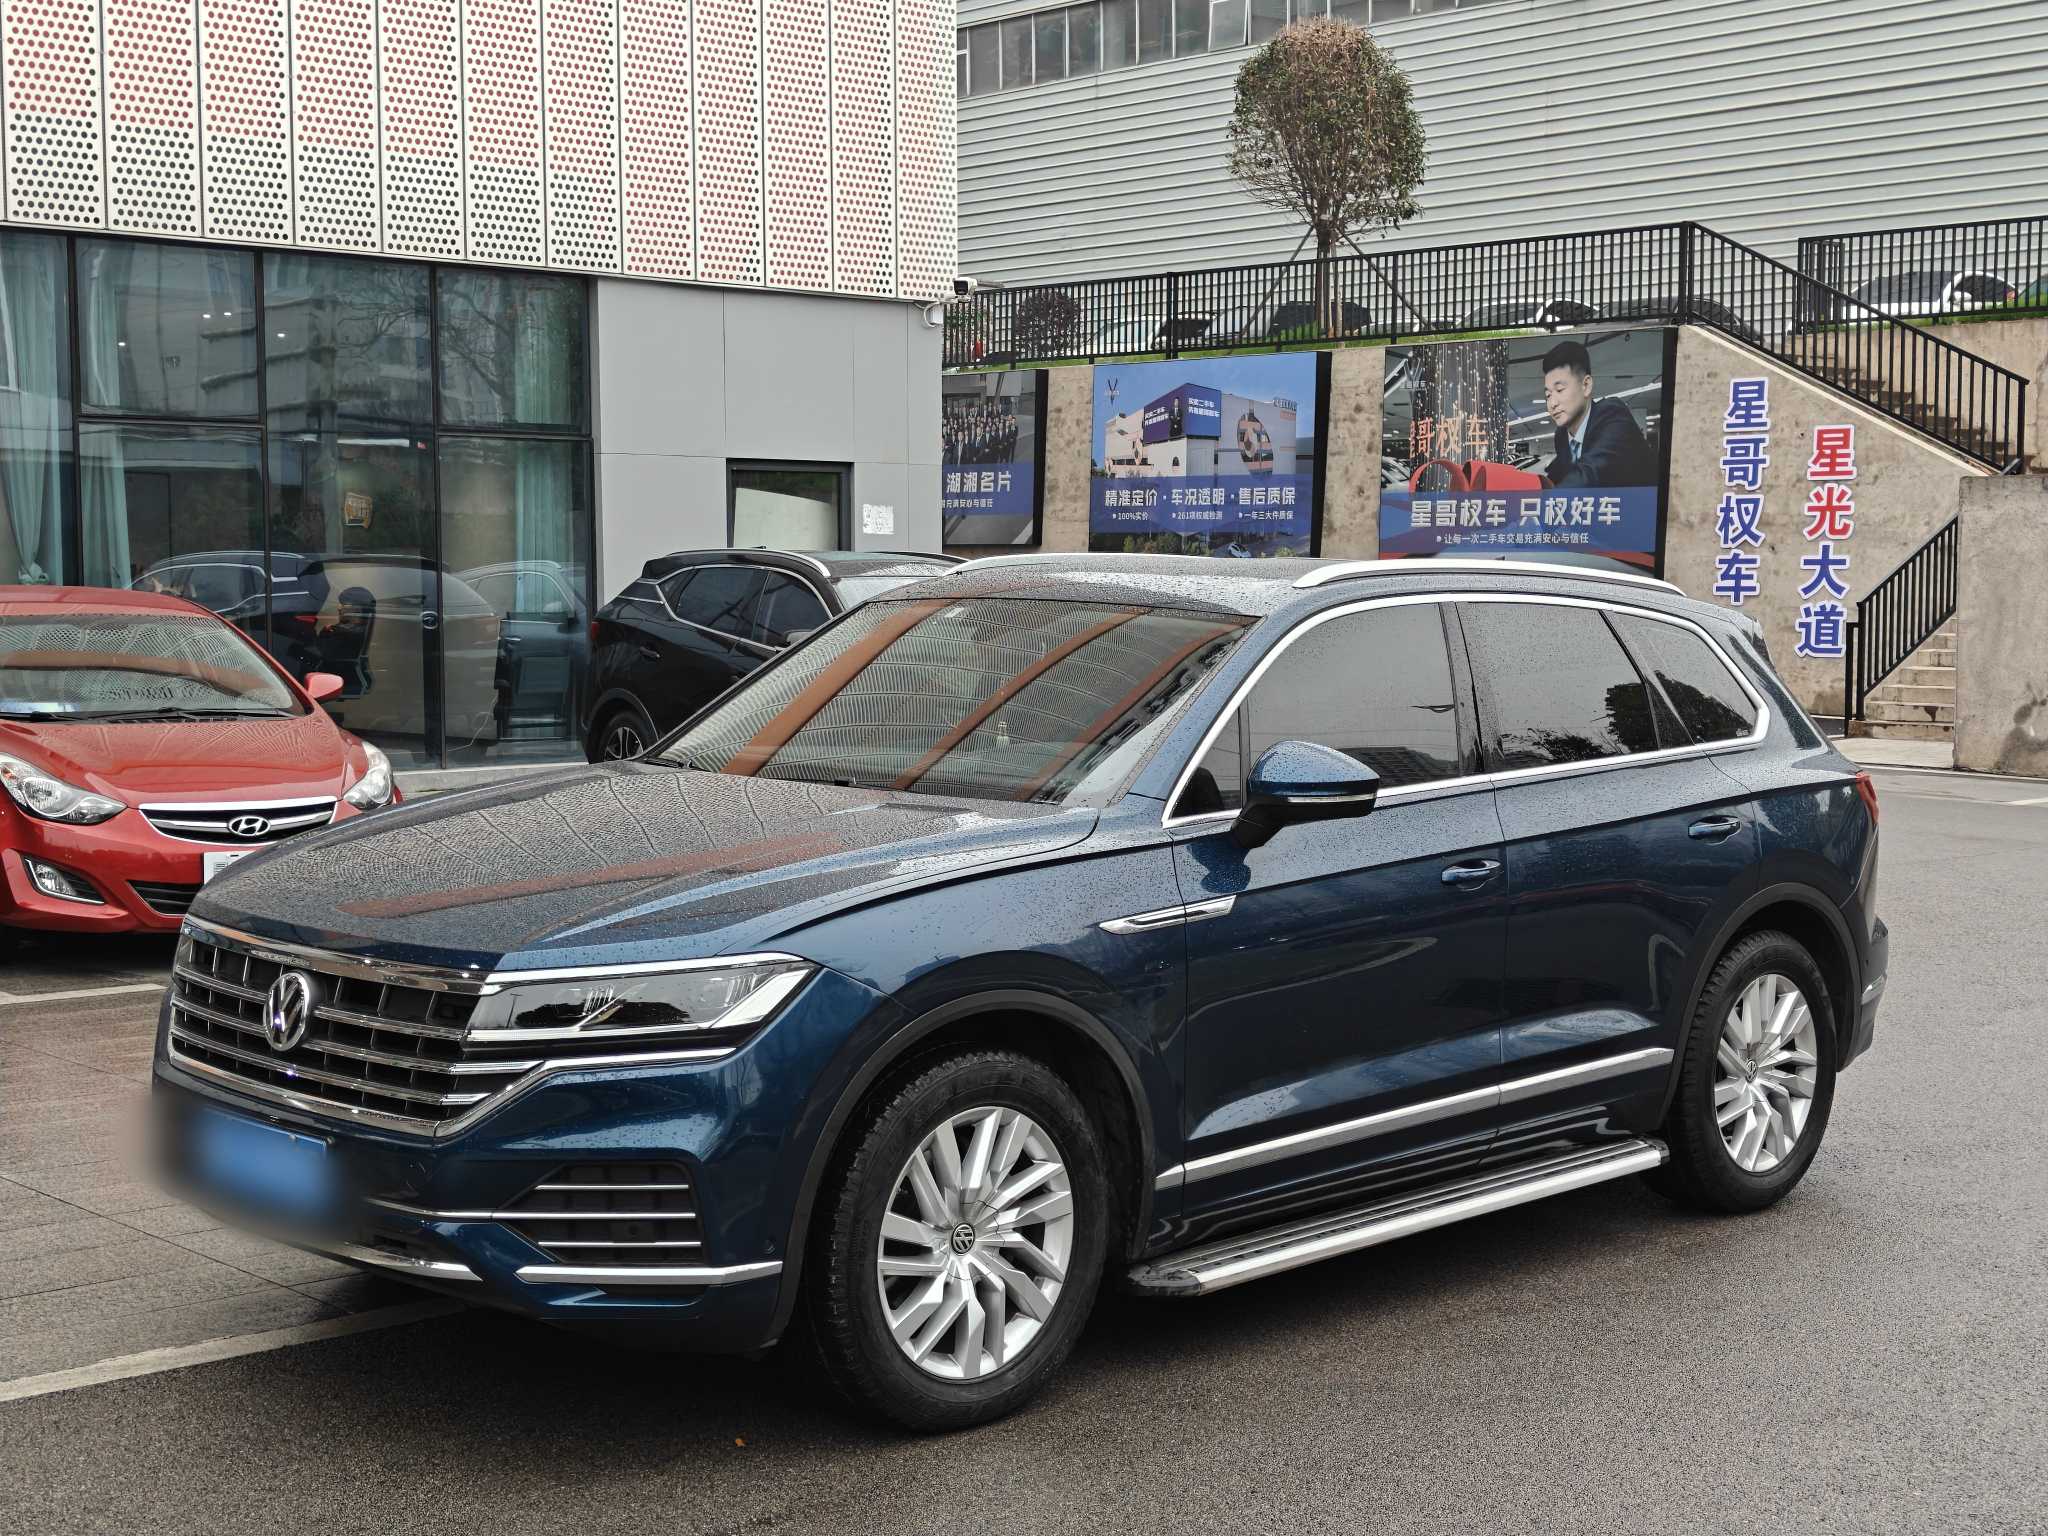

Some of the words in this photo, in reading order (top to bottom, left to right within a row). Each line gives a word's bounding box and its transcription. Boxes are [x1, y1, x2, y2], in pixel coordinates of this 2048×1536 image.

[946, 471, 1012, 493] 湖湘名片
[1104, 488, 1158, 507] 精准定价
[1171, 488, 1225, 506] 车况透明
[1239, 487, 1296, 505] 售后质保
[1443, 532, 1589, 545] 让每一次二手车交易充满安心与信任
[1797, 427, 1854, 656] 星光大道
